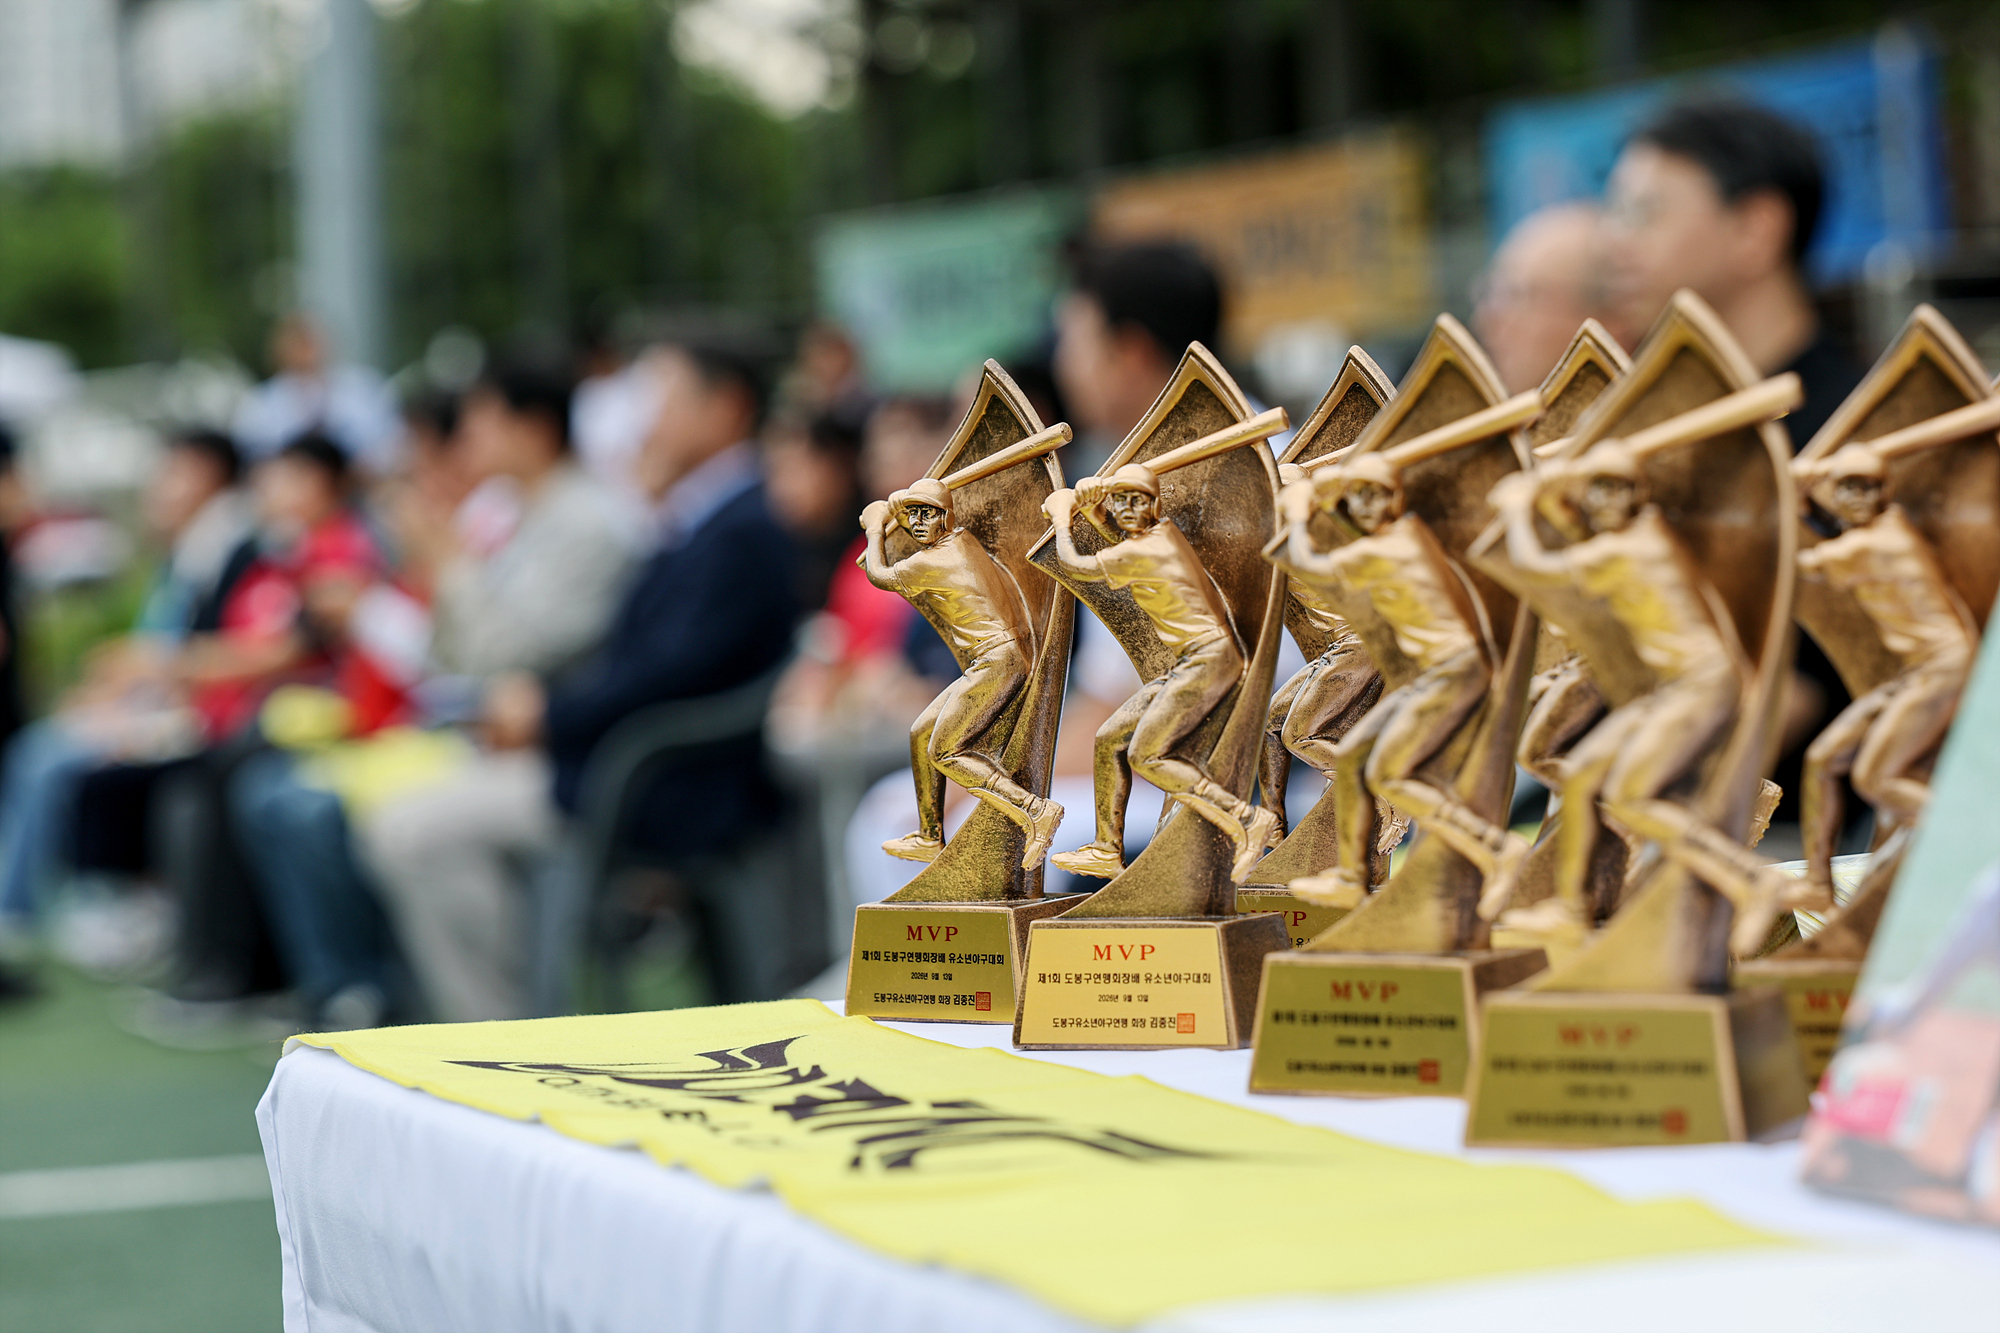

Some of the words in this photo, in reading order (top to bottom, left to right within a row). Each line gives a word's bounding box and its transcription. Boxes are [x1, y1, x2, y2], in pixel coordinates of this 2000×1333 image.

[906, 925, 959, 942] MVP
[861, 950, 882, 962] 제1회
[883, 951, 946, 964] 도봉구연맹회장배
[948, 953, 1005, 966] 유소년야구대회
[1092, 944, 1156, 961] MVP
[1037, 973, 1061, 985] 제1회
[1064, 973, 1141, 985] 도봉구연맹회장배
[1144, 973, 1212, 985] 유소년야구대회
[873, 992, 936, 1005] 도봉구유소년야구연맹
[938, 995, 951, 1005] 회장
[953, 995, 976, 1006] 김종진
[1122, 994, 1133, 1003] 9월
[1329, 980, 1400, 1004] MVP
[1052, 1017, 1128, 1029] 도봉구유소년야구연맹
[1131, 1017, 1147, 1029] 회장
[1150, 1016, 1176, 1029] 김종진
